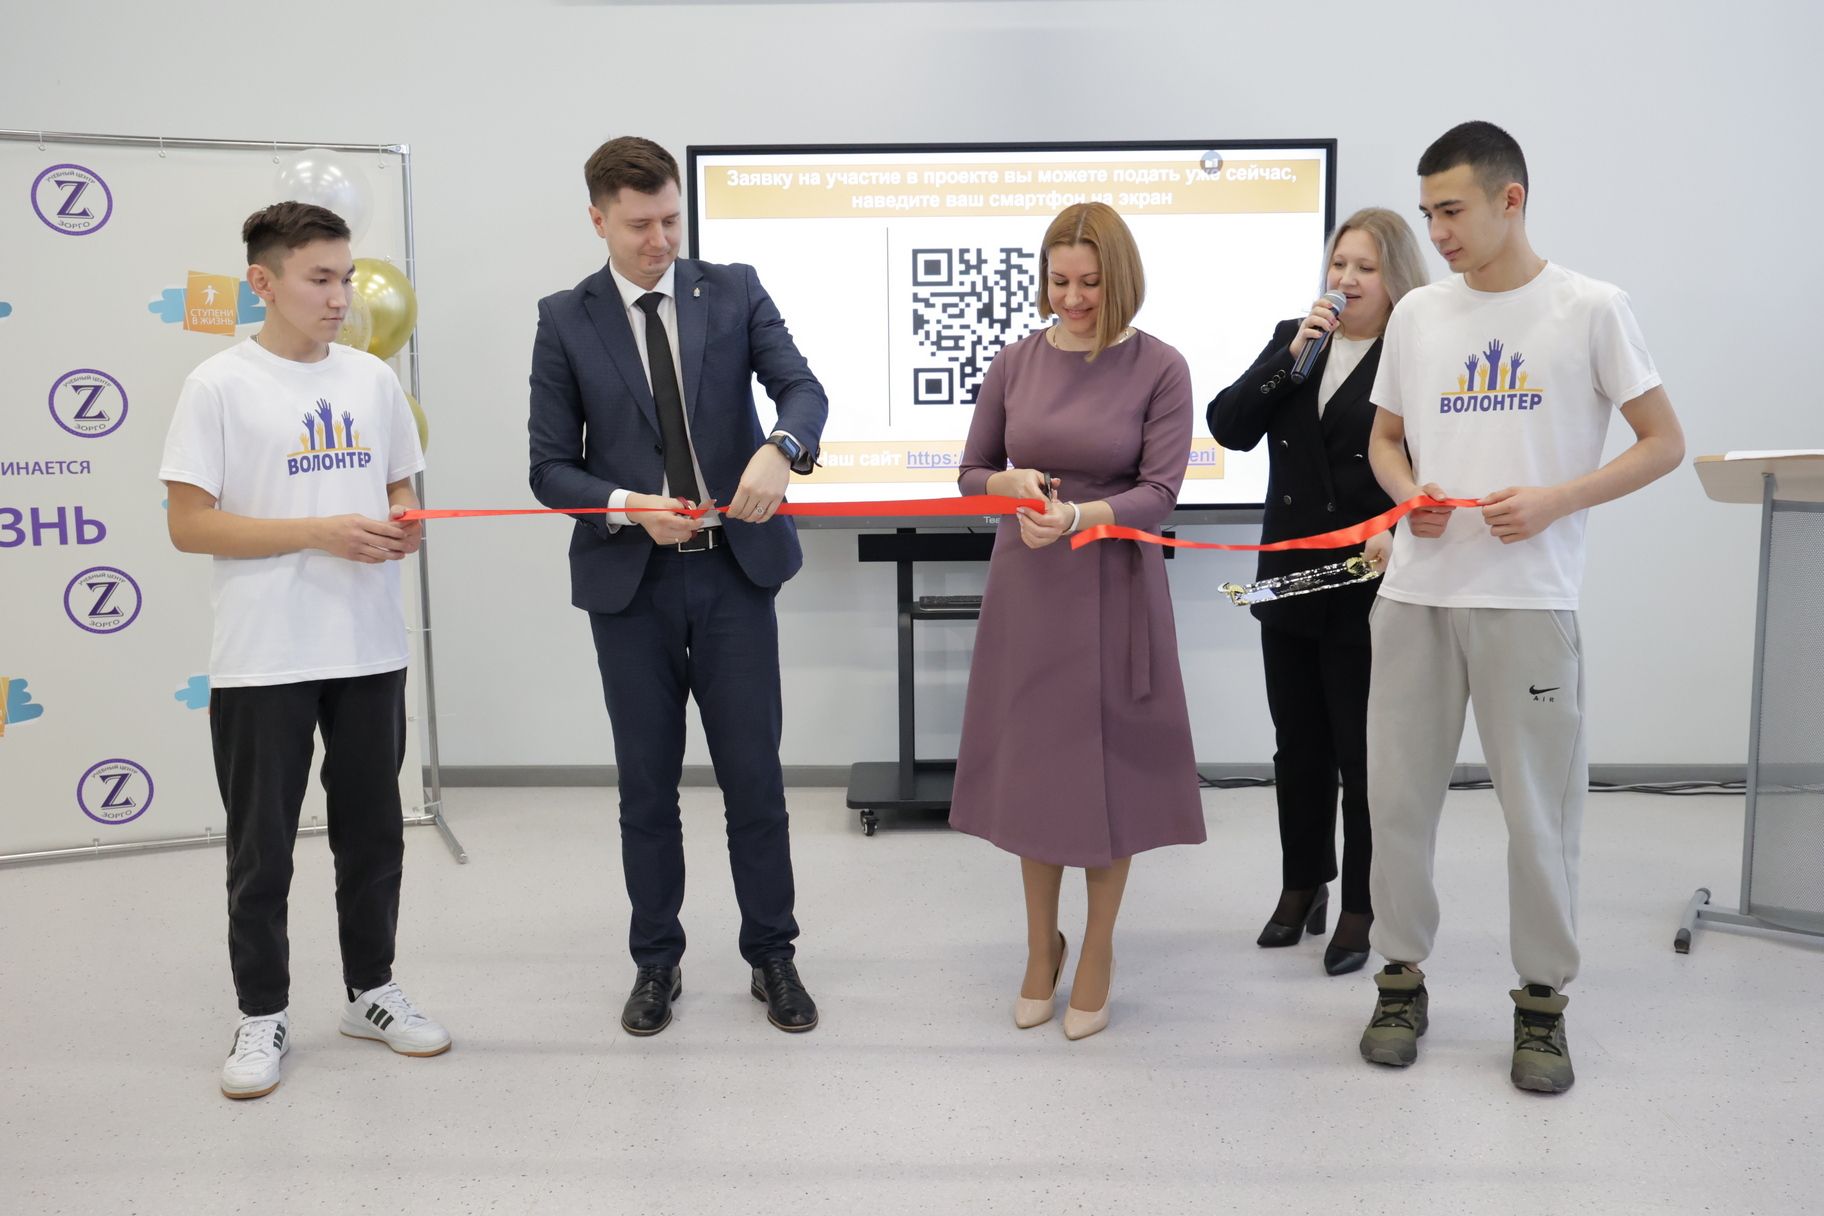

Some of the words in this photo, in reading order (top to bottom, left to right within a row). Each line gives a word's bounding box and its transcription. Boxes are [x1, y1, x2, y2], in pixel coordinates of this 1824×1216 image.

[727, 169, 793, 190] Заявку
[799, 170, 821, 186] на
[825, 170, 901, 189] участие
[907, 171, 918, 185] в
[923, 169, 1000, 187] проекте
[1004, 169, 1032, 184] вы
[1038, 168, 1108, 183] можете
[1113, 168, 1181, 185] подать
[1185, 166, 1220, 185] уже
[1225, 164, 1297, 183] сейчас,
[54, 180, 94, 219] Z
[852, 194, 940, 210] наведите
[946, 193, 983, 208] ваш
[1118, 192, 1173, 209] экран
[58, 220, 90, 229] ЗОРГО
[190, 308, 234, 318] СТУПЕНИ
[192, 317, 199, 325] В
[200, 316, 234, 325] ЖИЗНЬ
[71, 385, 110, 421] Z
[1440, 393, 1543, 414] ВОЛОНТЕР
[75, 423, 106, 432] ЗОРГО
[287, 451, 372, 476] ВОЛОНТЕР
[859, 449, 901, 467] сайт
[1, 460, 91, 476] ИНАЕТСЯ
[0, 506, 107, 548] ЗНЬ
[86, 581, 124, 618] Z
[88, 619, 120, 628] ЗОРГО
[99, 773, 137, 810] Z
[102, 809, 133, 819] ЗОРГО
